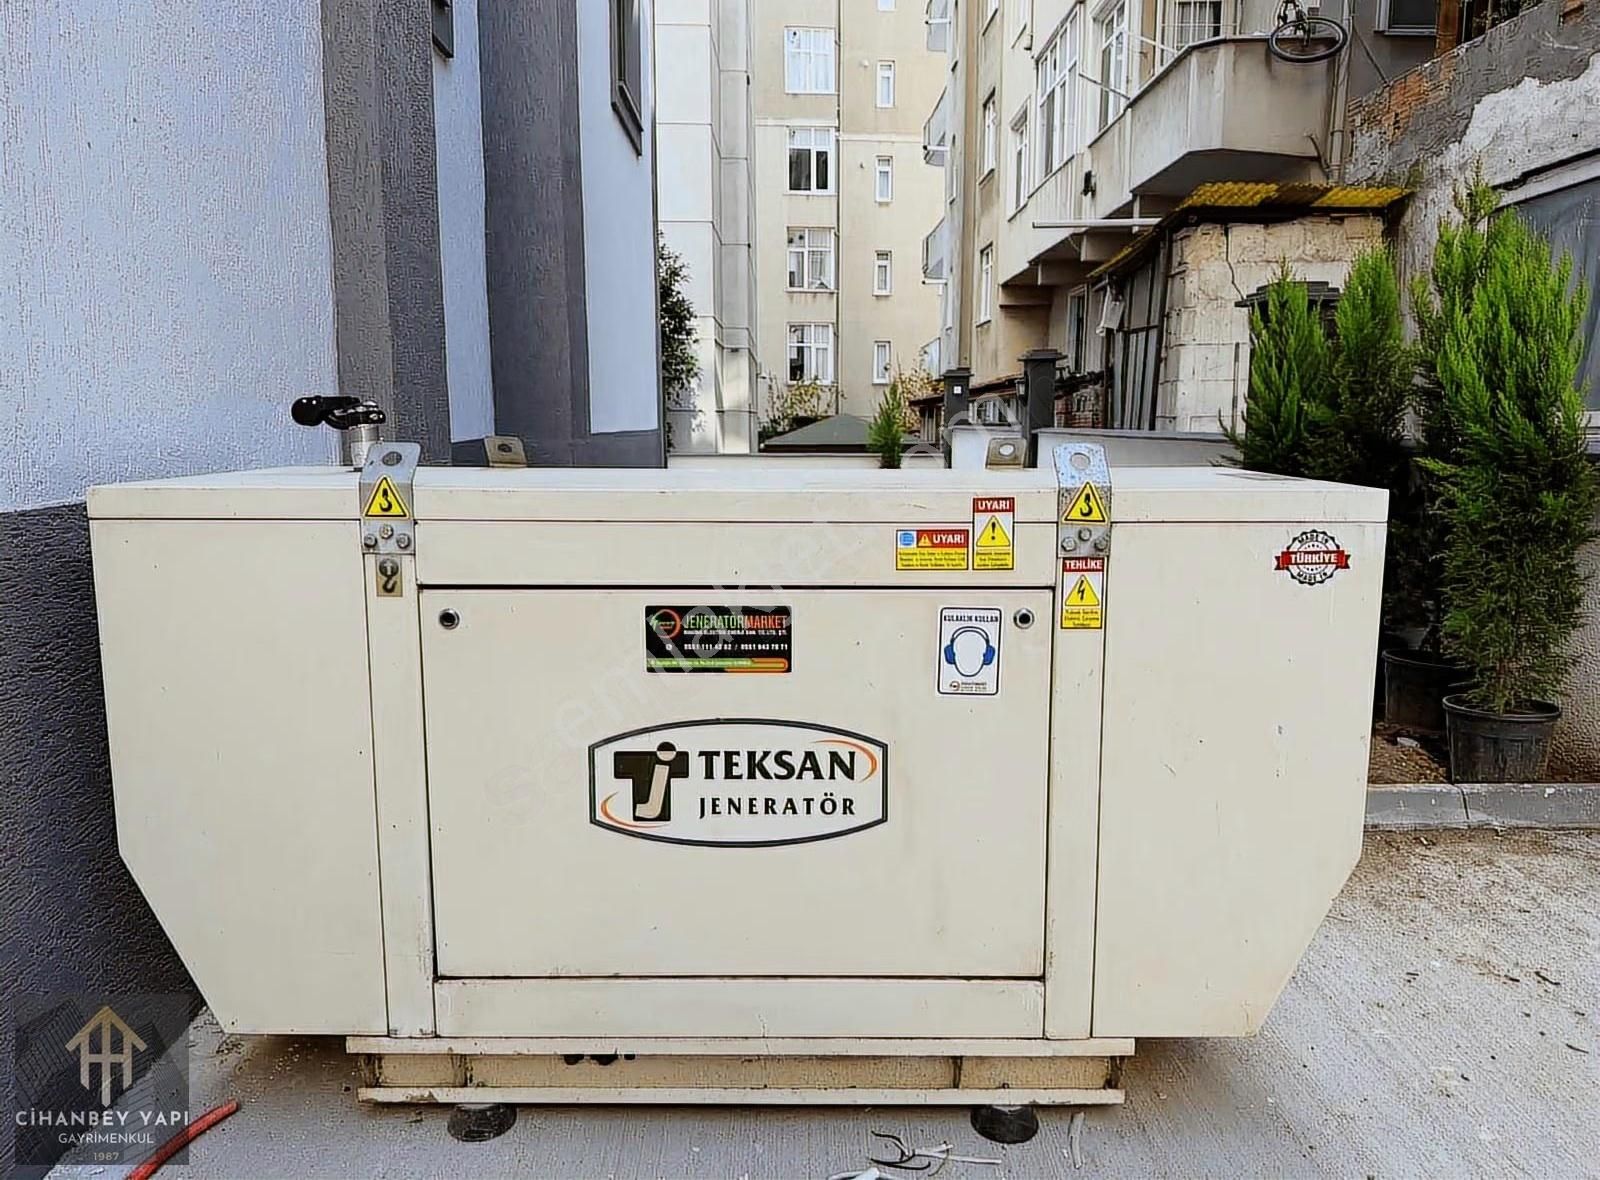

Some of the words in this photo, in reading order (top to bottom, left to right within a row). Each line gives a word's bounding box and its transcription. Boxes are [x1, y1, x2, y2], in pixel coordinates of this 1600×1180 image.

[978, 500, 1010, 510] UYARI
[933, 533, 965, 544] UYARI
[1290, 551, 1338, 564] TÜRKİYE
[1065, 558, 1103, 570] TEHLİKE
[698, 750, 856, 781] TEKSAN
[699, 792, 856, 819] JENERATÖR
